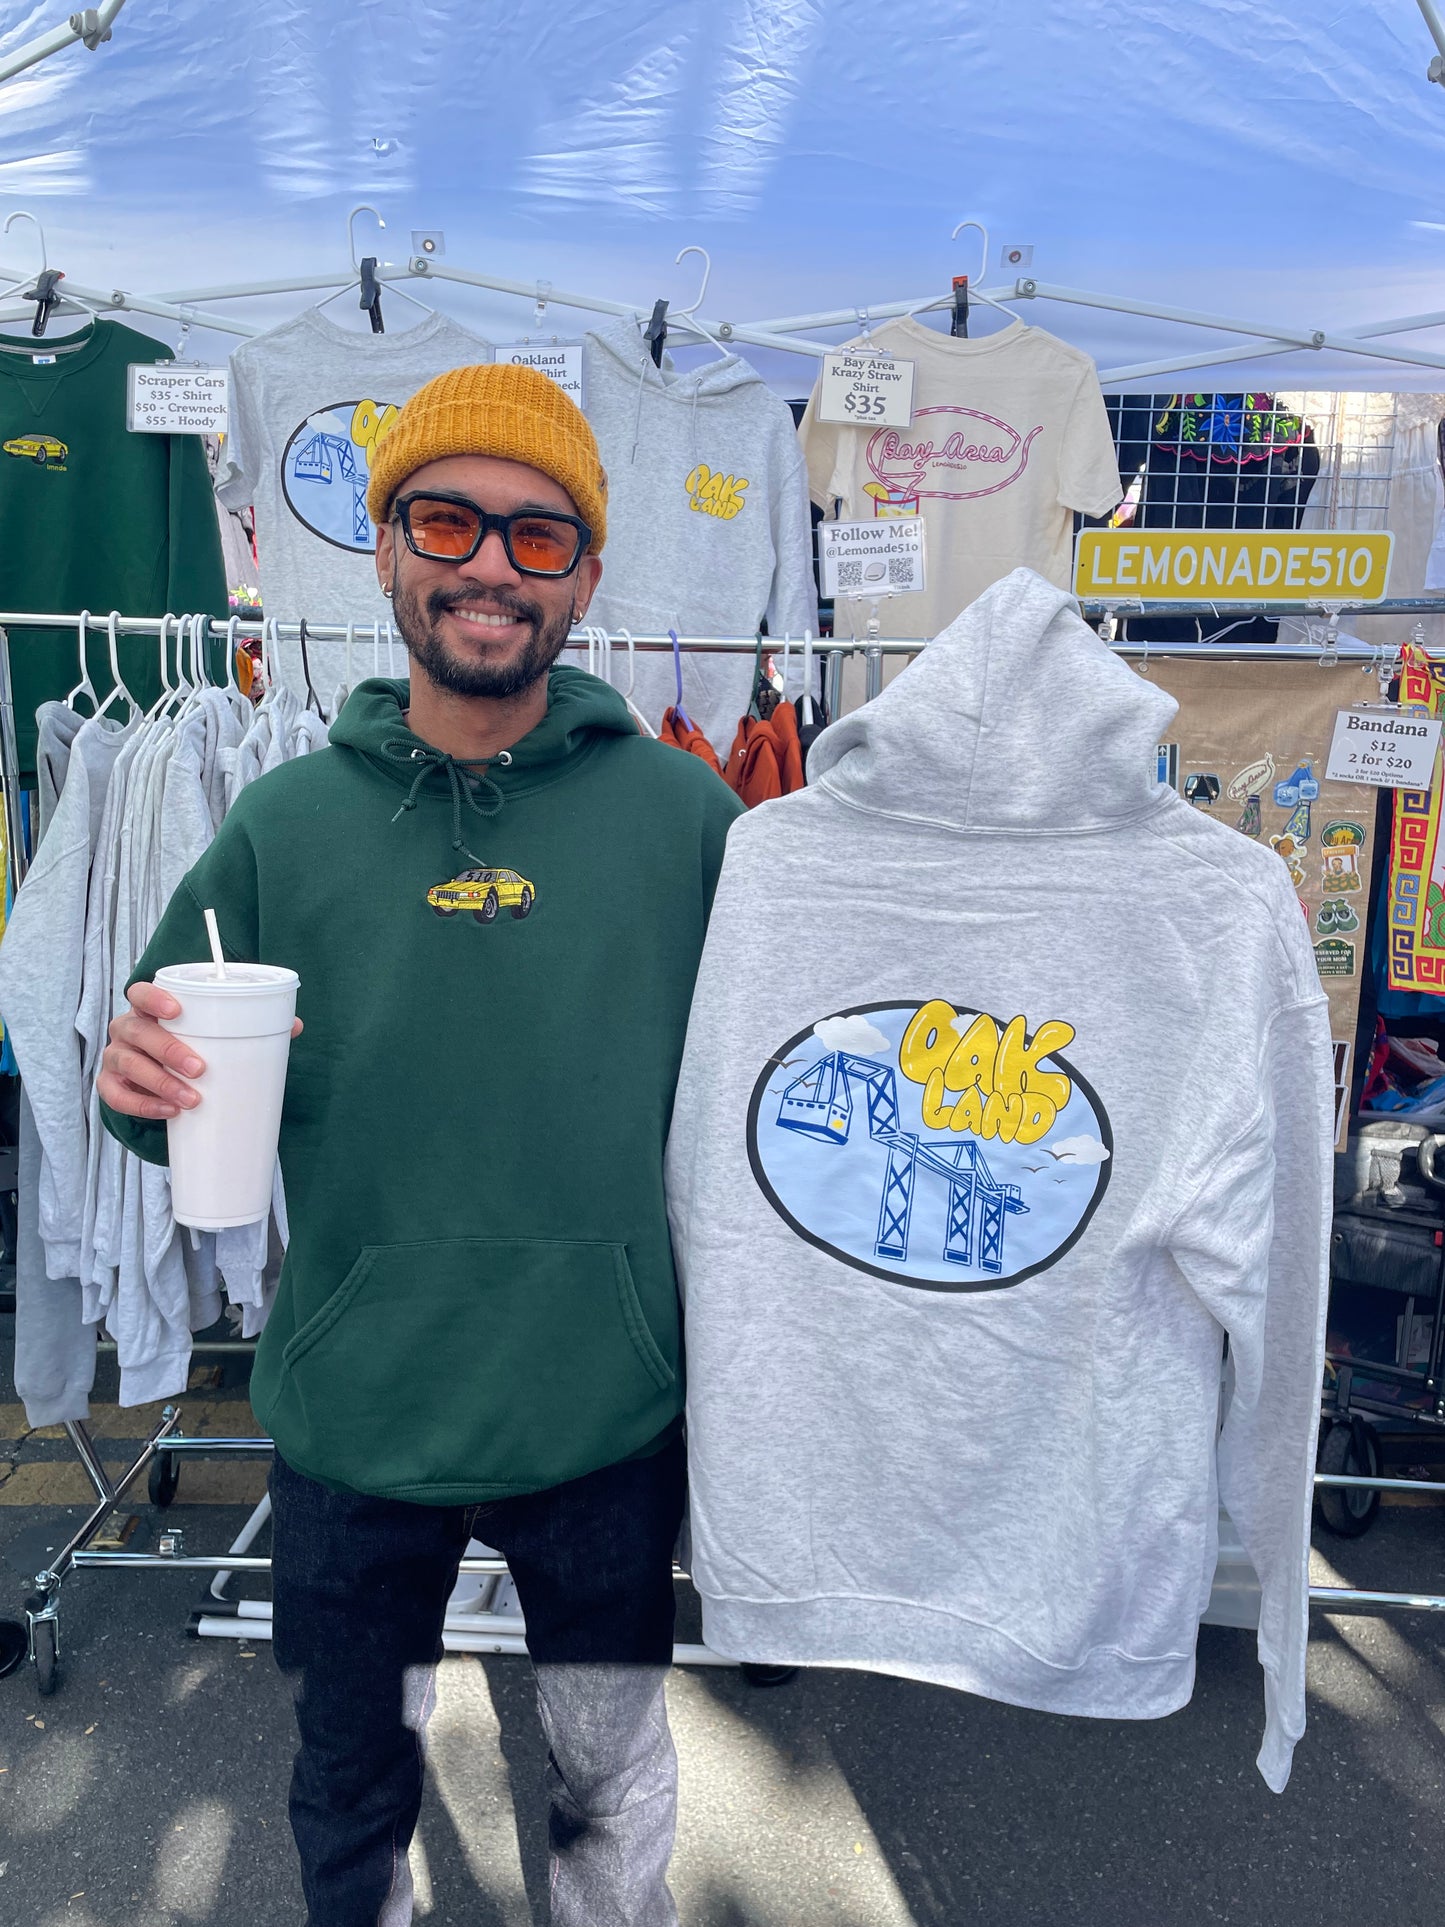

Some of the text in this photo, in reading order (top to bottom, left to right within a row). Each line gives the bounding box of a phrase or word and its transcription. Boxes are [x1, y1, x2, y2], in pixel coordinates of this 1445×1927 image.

[511, 354, 565, 365] Oakland
[843, 357, 895, 370] Bay Area
[831, 366, 903, 381] Krazy Straw
[137, 374, 225, 388] Scraper Cars
[852, 382, 880, 392] Shirt
[150, 390, 171, 400] $35
[182, 390, 213, 400] Shirt
[135, 402, 157, 412] $50
[168, 403, 227, 414] Crewneck
[844, 392, 887, 415] $35
[145, 415, 167, 426] $55
[178, 416, 216, 428] Hoody
[883, 432, 1010, 469] Bay Area
[830, 524, 918, 542] Follow Me!
[1091, 545, 1373, 587] LEMONADE510
[1346, 716, 1428, 737] Bandana
[1370, 740, 1396, 752] $12
[1348, 753, 1412, 769] 2 for $20
[465, 871, 493, 883] 510
[899, 998, 1076, 1112] OAK
[921, 1067, 1057, 1144] LAND
